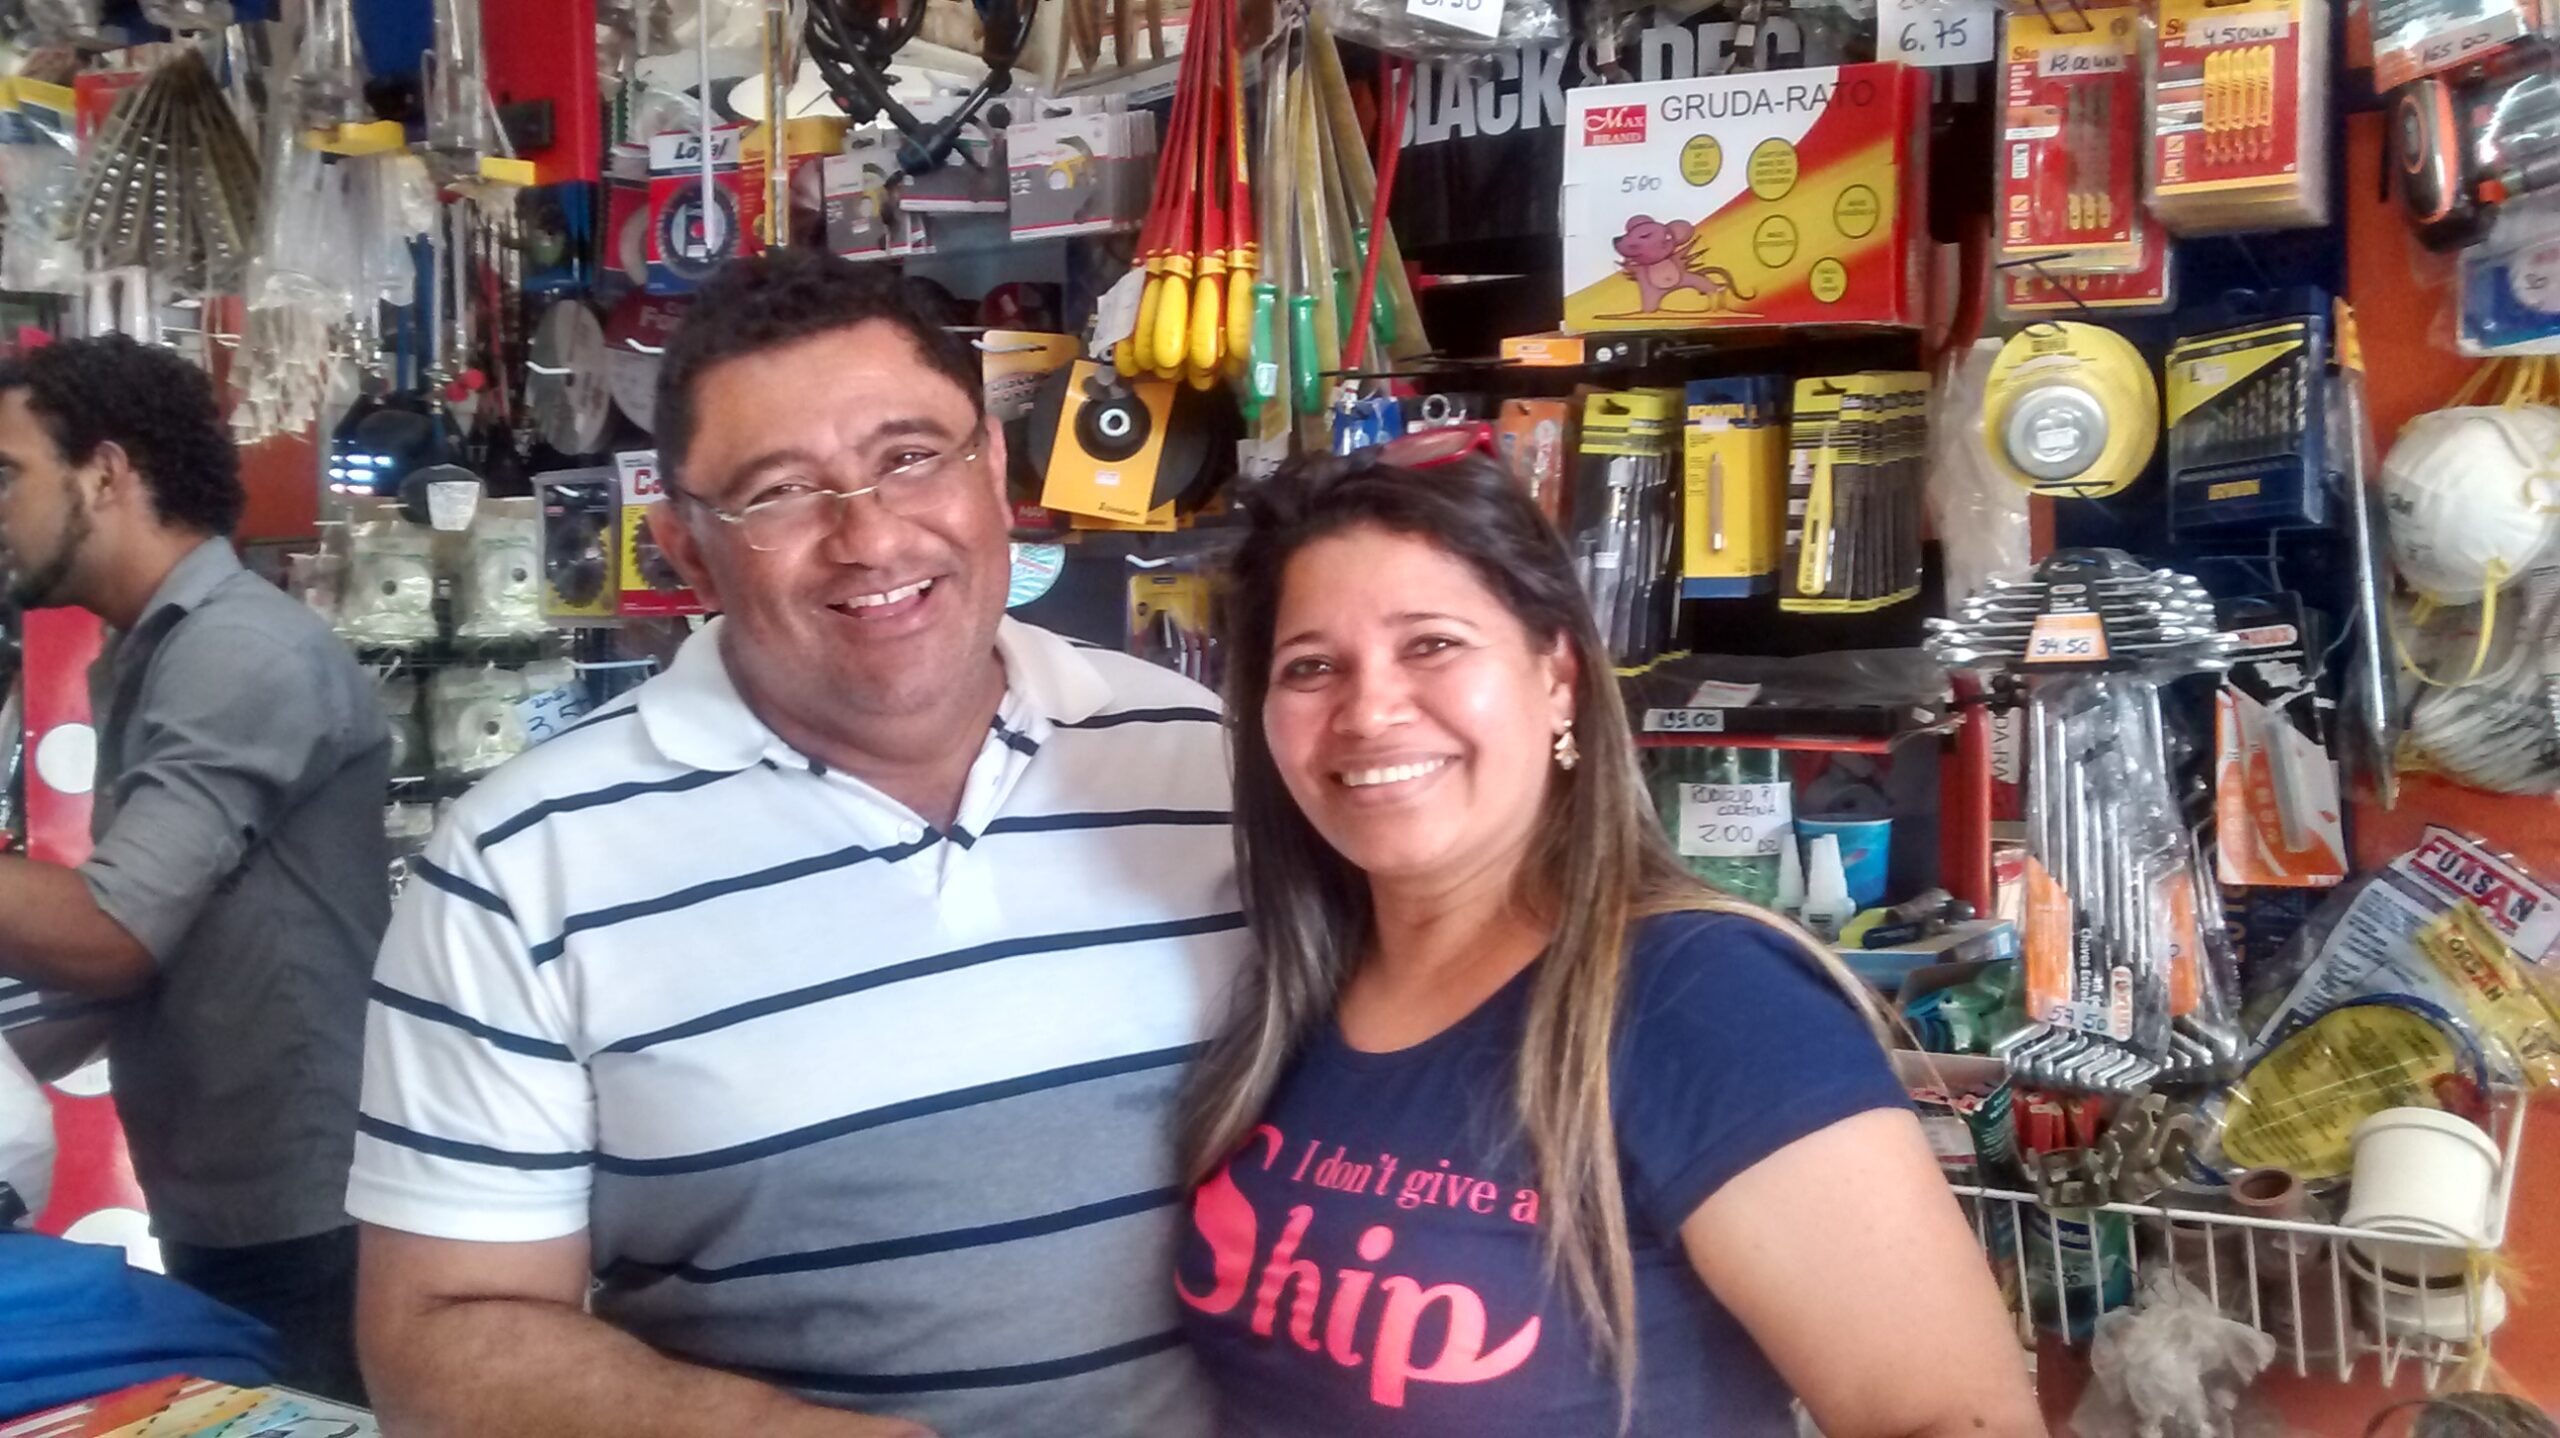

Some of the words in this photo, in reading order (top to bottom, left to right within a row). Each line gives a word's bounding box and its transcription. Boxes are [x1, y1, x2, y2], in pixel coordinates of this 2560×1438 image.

[1899, 17, 1968, 52] 6.75
[1660, 79, 1877, 122] GRUDA-RATO
[674, 137, 729, 162] Loal
[1592, 133, 1643, 145] BRAND
[1290, 1139, 1322, 1182] I
[1313, 1145, 1400, 1197] don't
[1396, 1159, 1498, 1213] give
[1509, 1188, 1541, 1225] a
[1174, 1123, 1542, 1408] Ship
